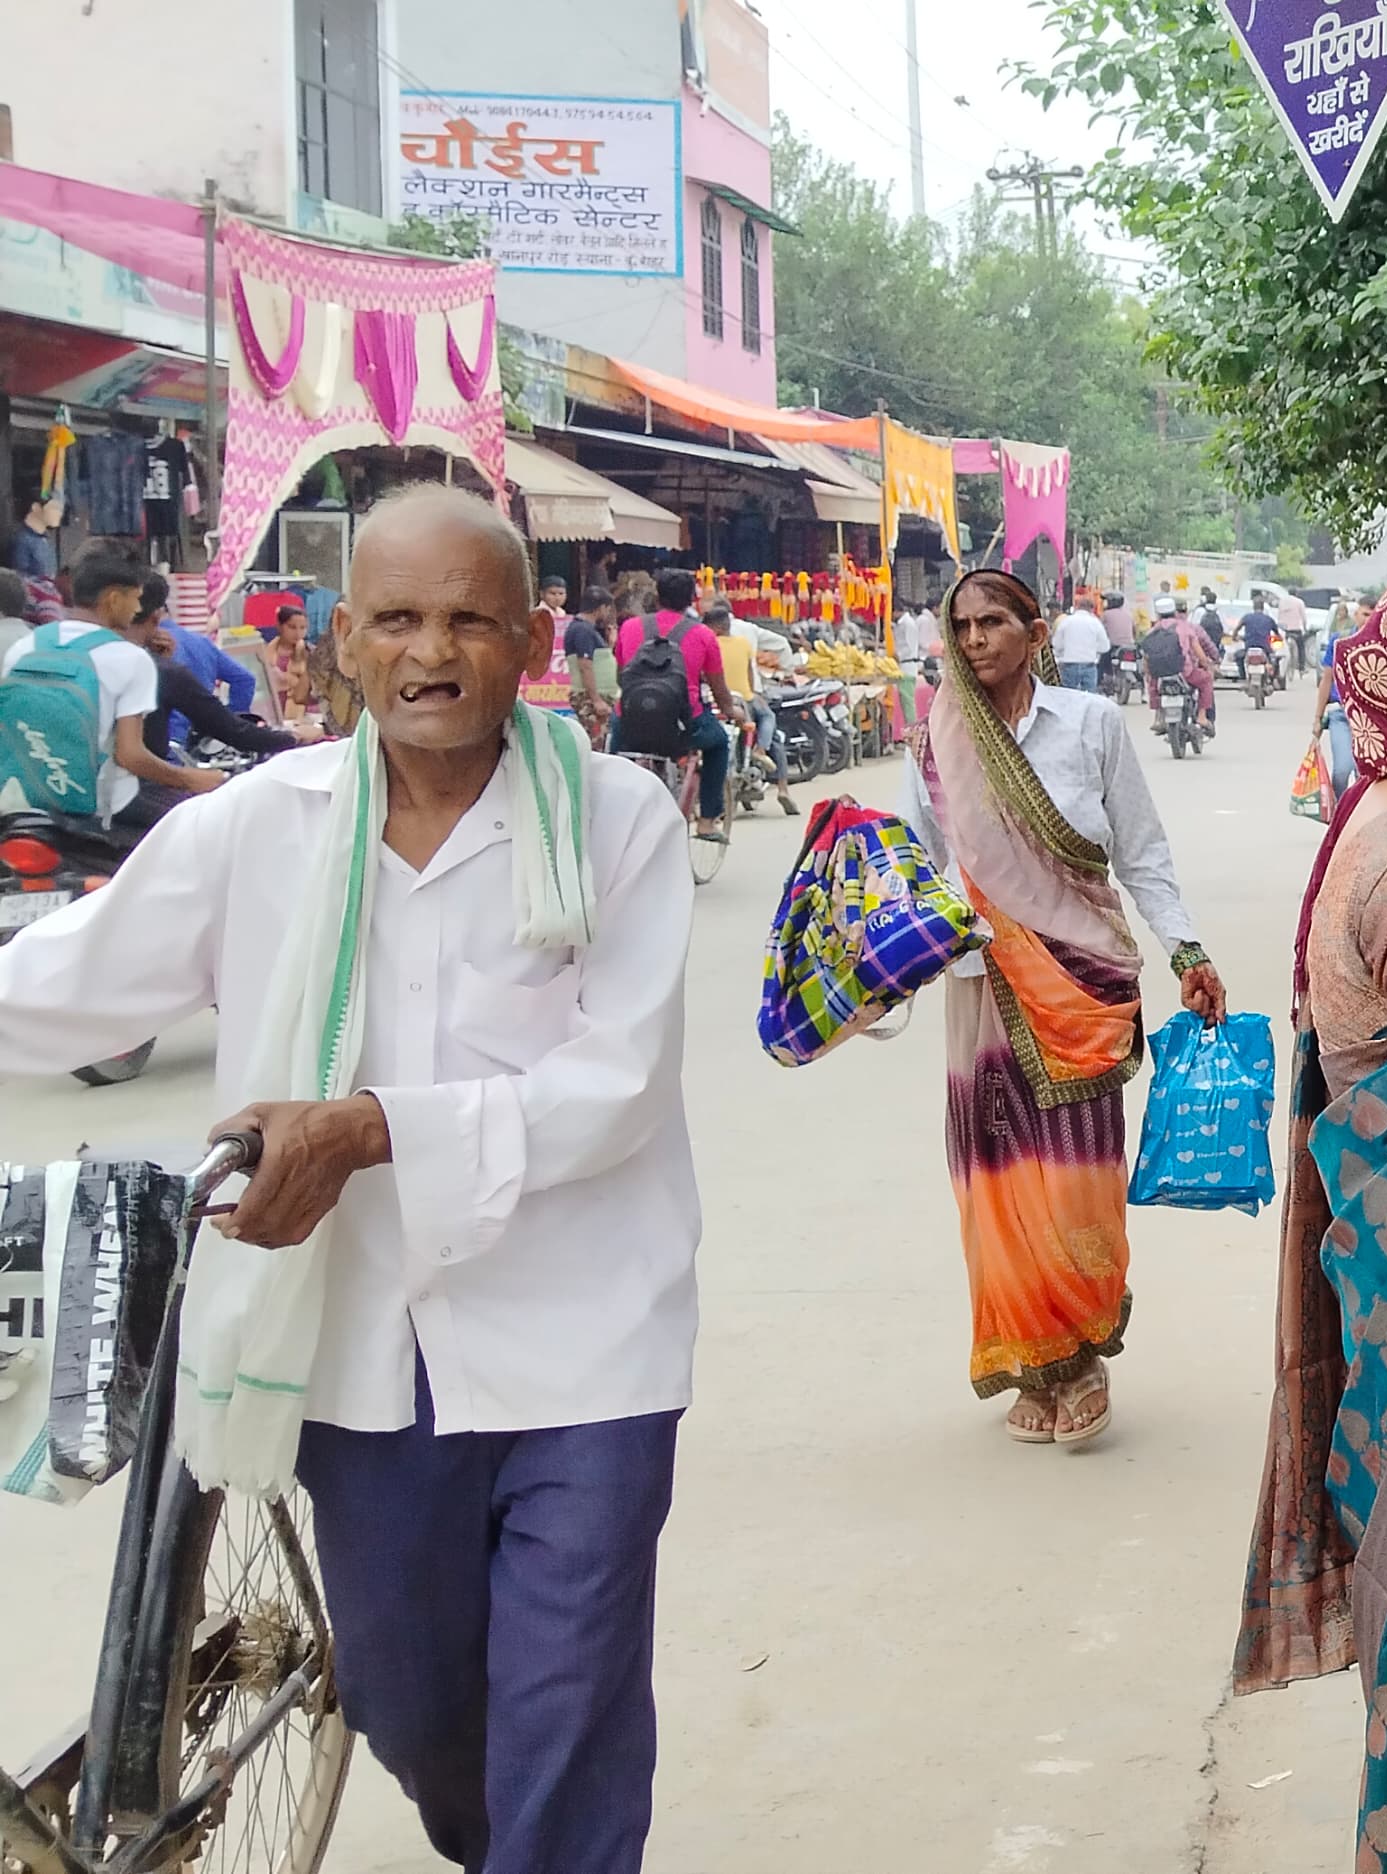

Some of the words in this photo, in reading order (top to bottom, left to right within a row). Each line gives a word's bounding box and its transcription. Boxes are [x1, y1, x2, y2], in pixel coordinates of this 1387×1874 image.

[1307, 76, 1348, 114] यहाँ
[1350, 71, 1370, 104] से
[1308, 109, 1369, 155] खरीदें
